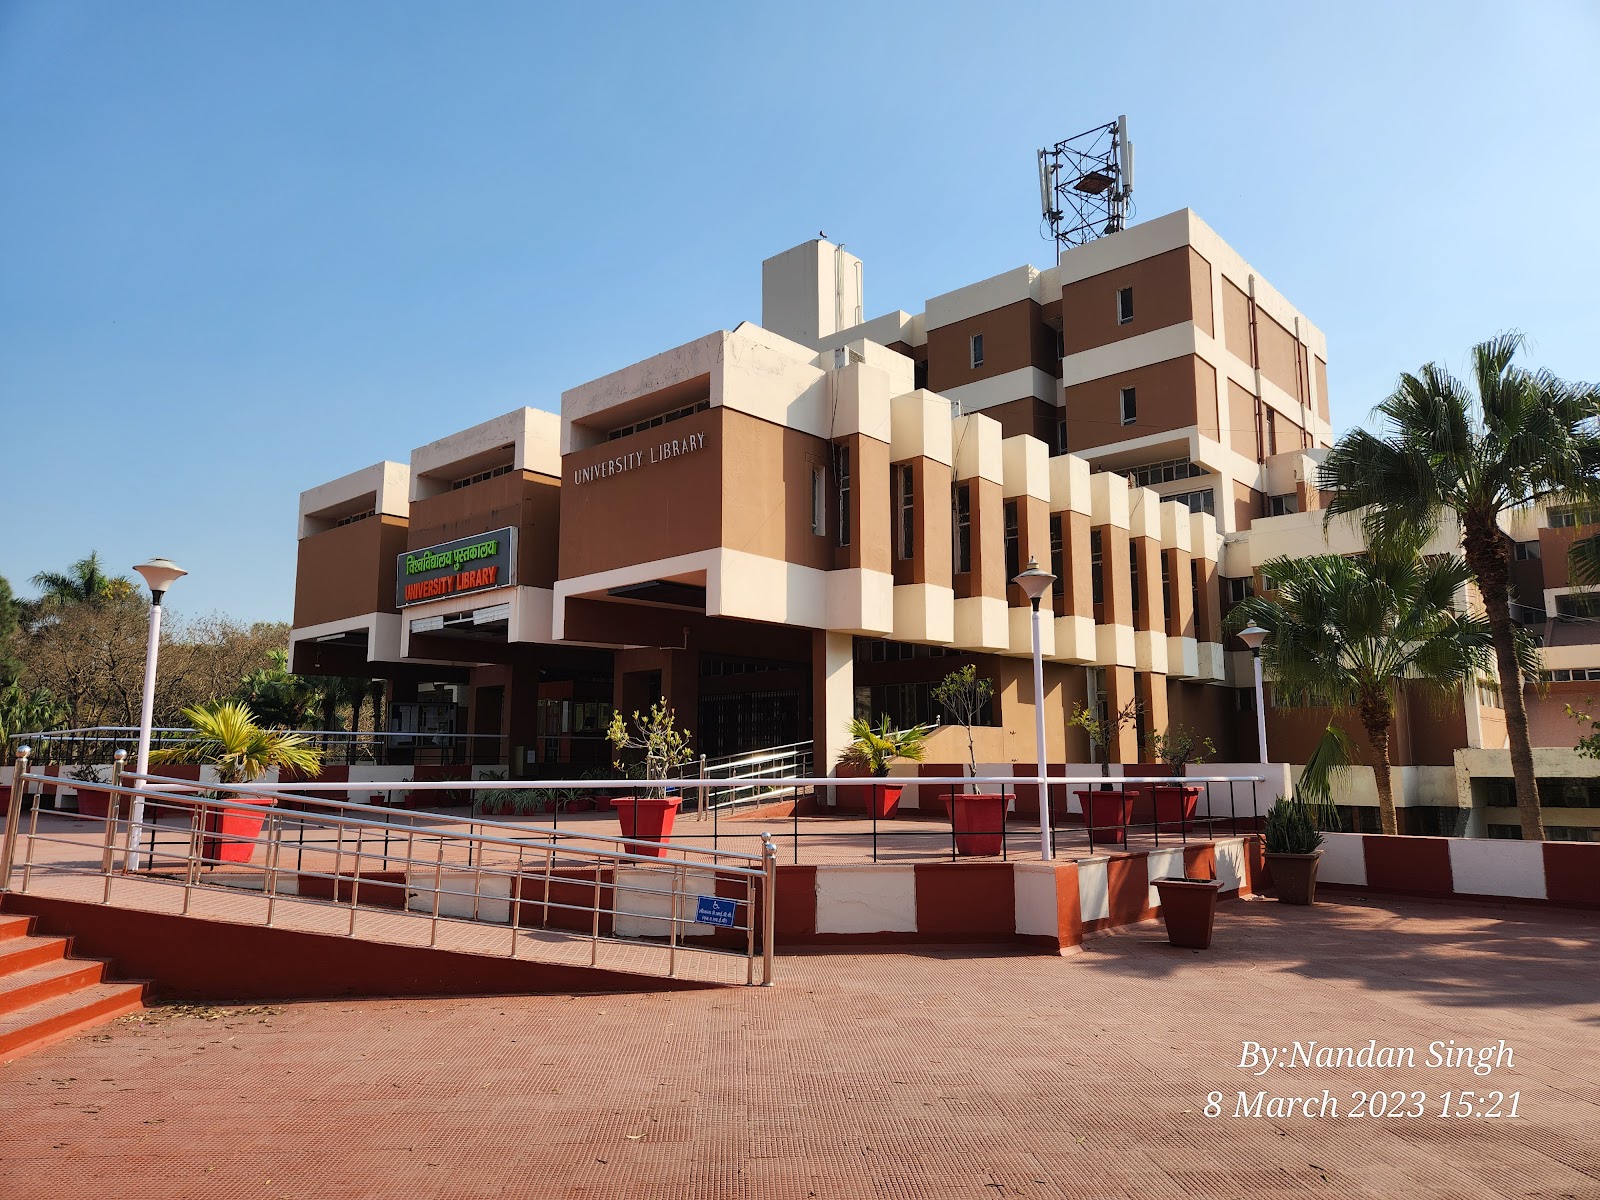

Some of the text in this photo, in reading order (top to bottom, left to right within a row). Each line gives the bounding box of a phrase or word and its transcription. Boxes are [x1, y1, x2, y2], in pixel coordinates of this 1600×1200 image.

[574, 431, 705, 484] UNIVERSITY LIBRARY
[406, 540, 498, 575] विश्वविद्यालय पुस्तकालय
[405, 566, 497, 600] UNIVERSITY LIBRARY
